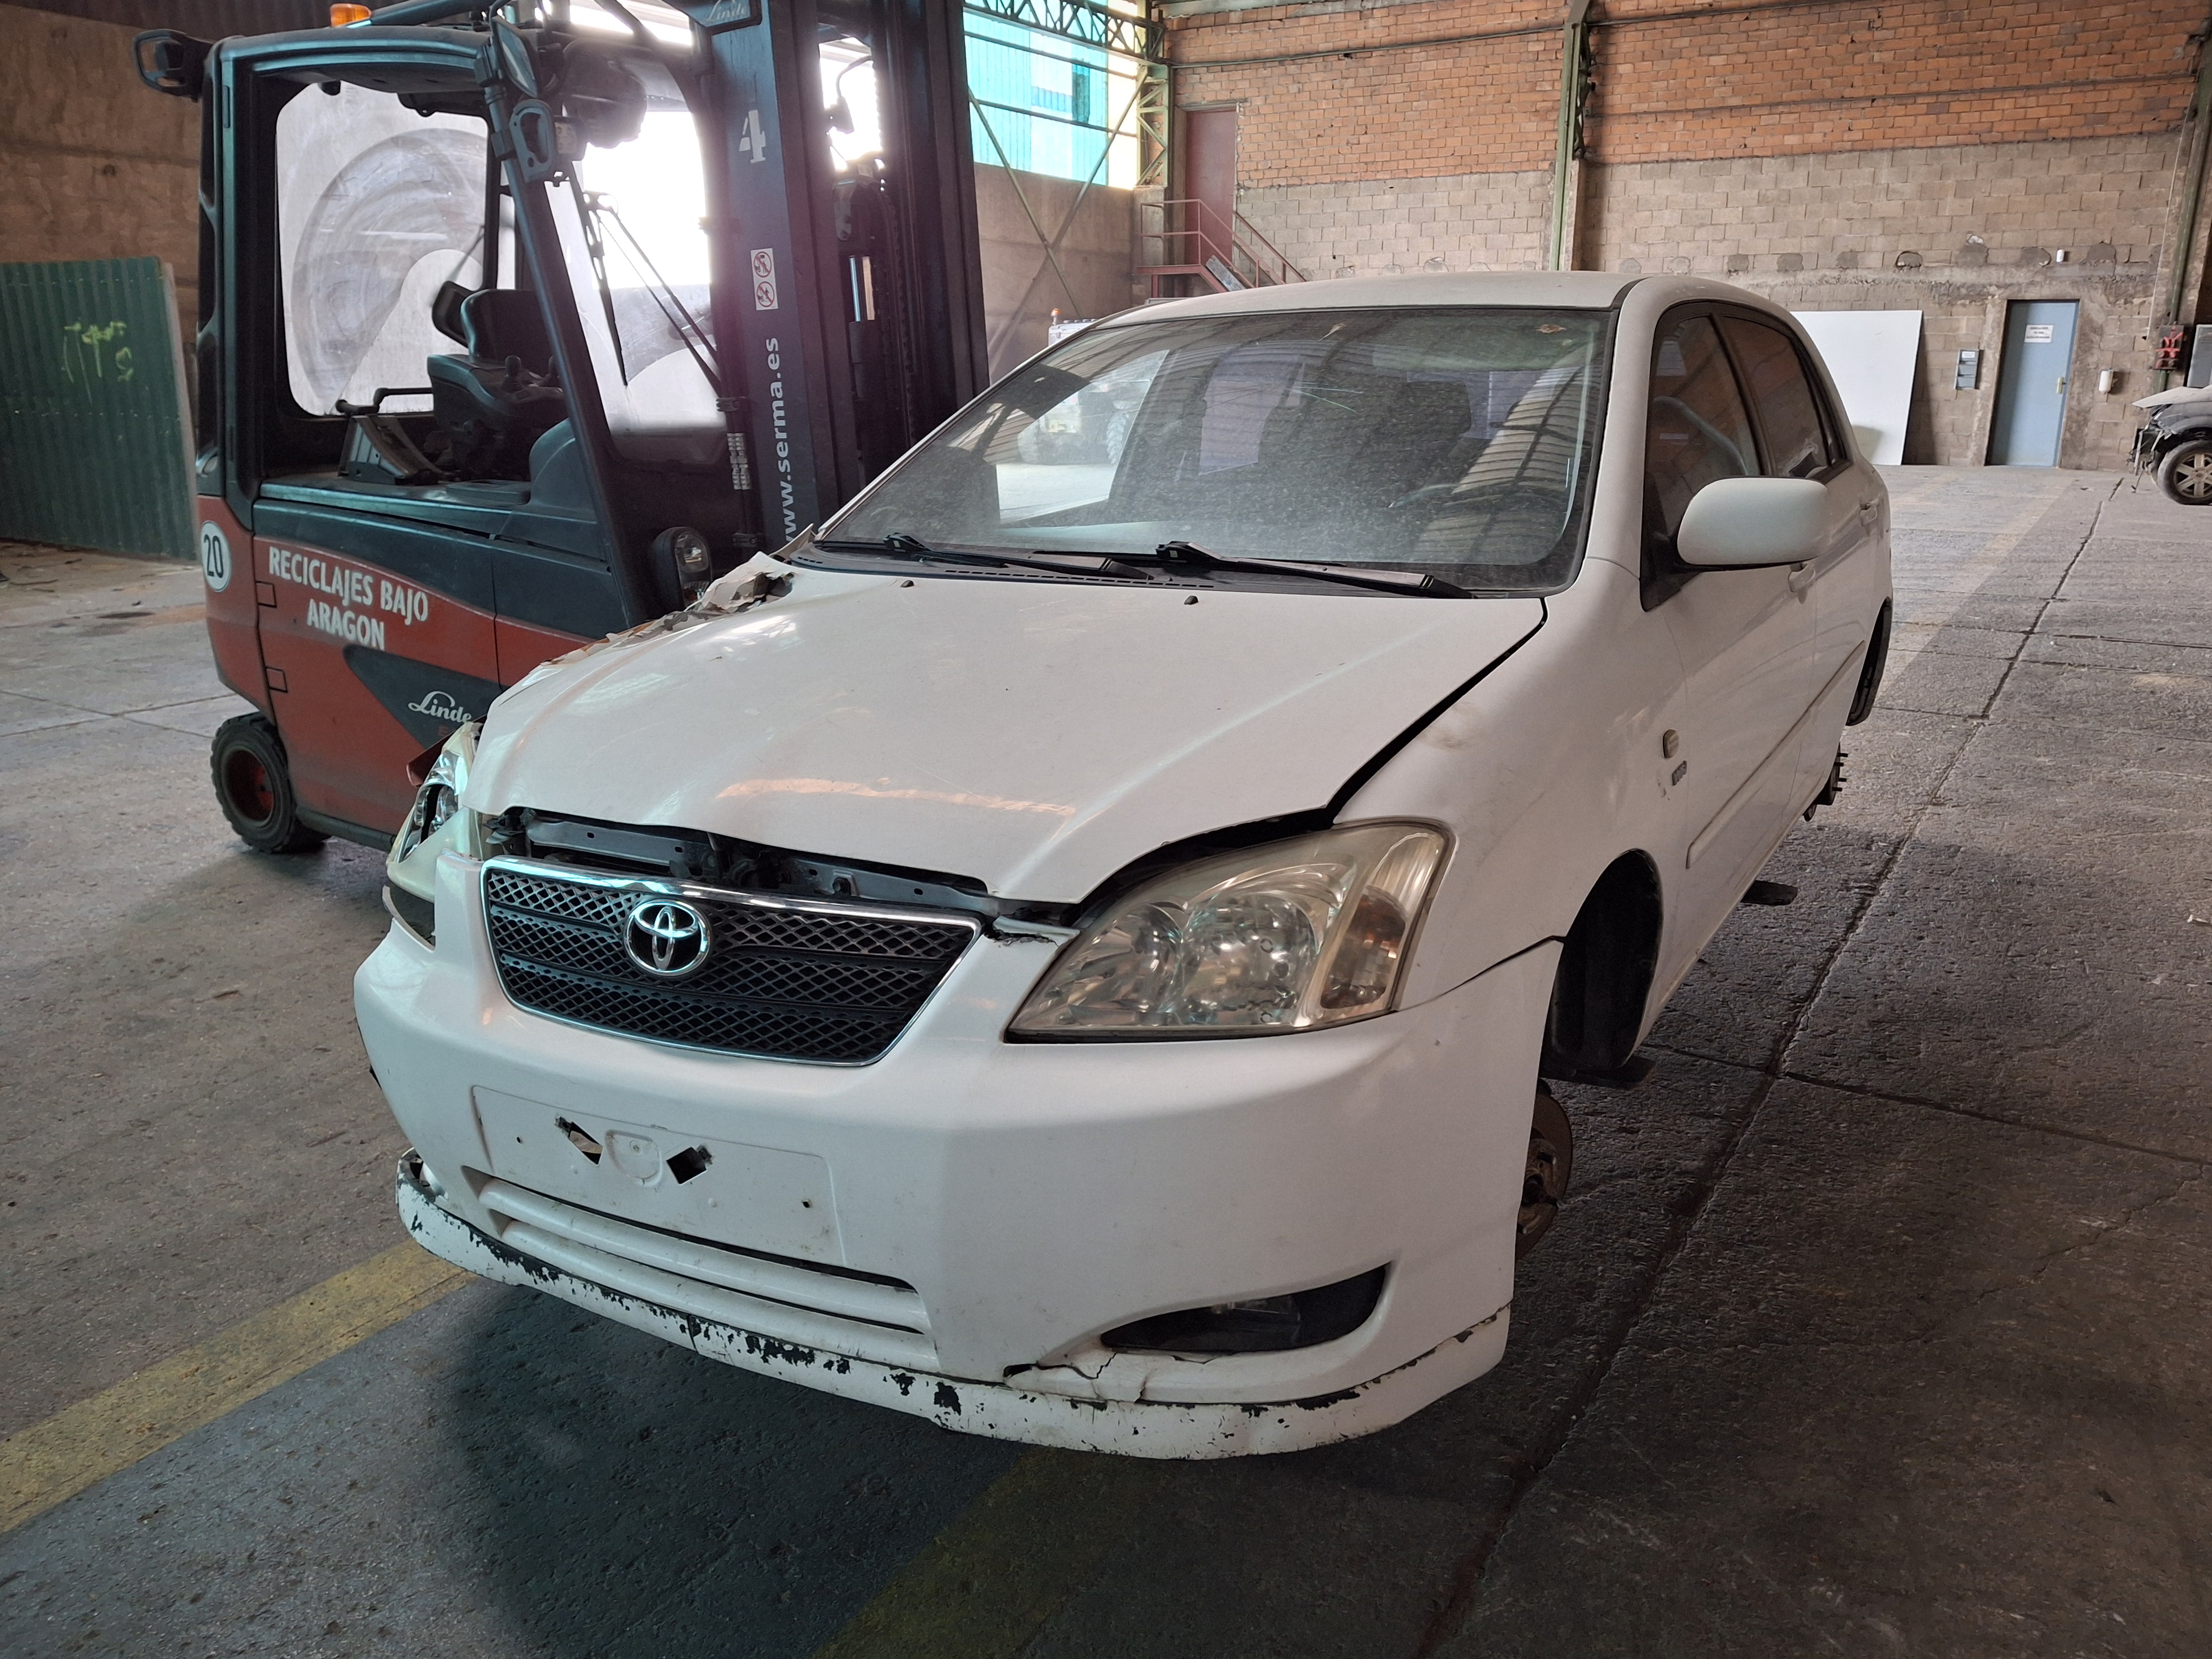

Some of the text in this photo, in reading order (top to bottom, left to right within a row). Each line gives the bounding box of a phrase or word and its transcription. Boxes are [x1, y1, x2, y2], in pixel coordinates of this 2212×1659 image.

[739, 110, 766, 163] 4
[766, 337, 797, 542] ww.serma.es
[204, 534, 224, 578] 20
[269, 546, 429, 626] RECICLAJES BAJO
[307, 598, 385, 651] ARAGON
[408, 691, 472, 723] Linde
